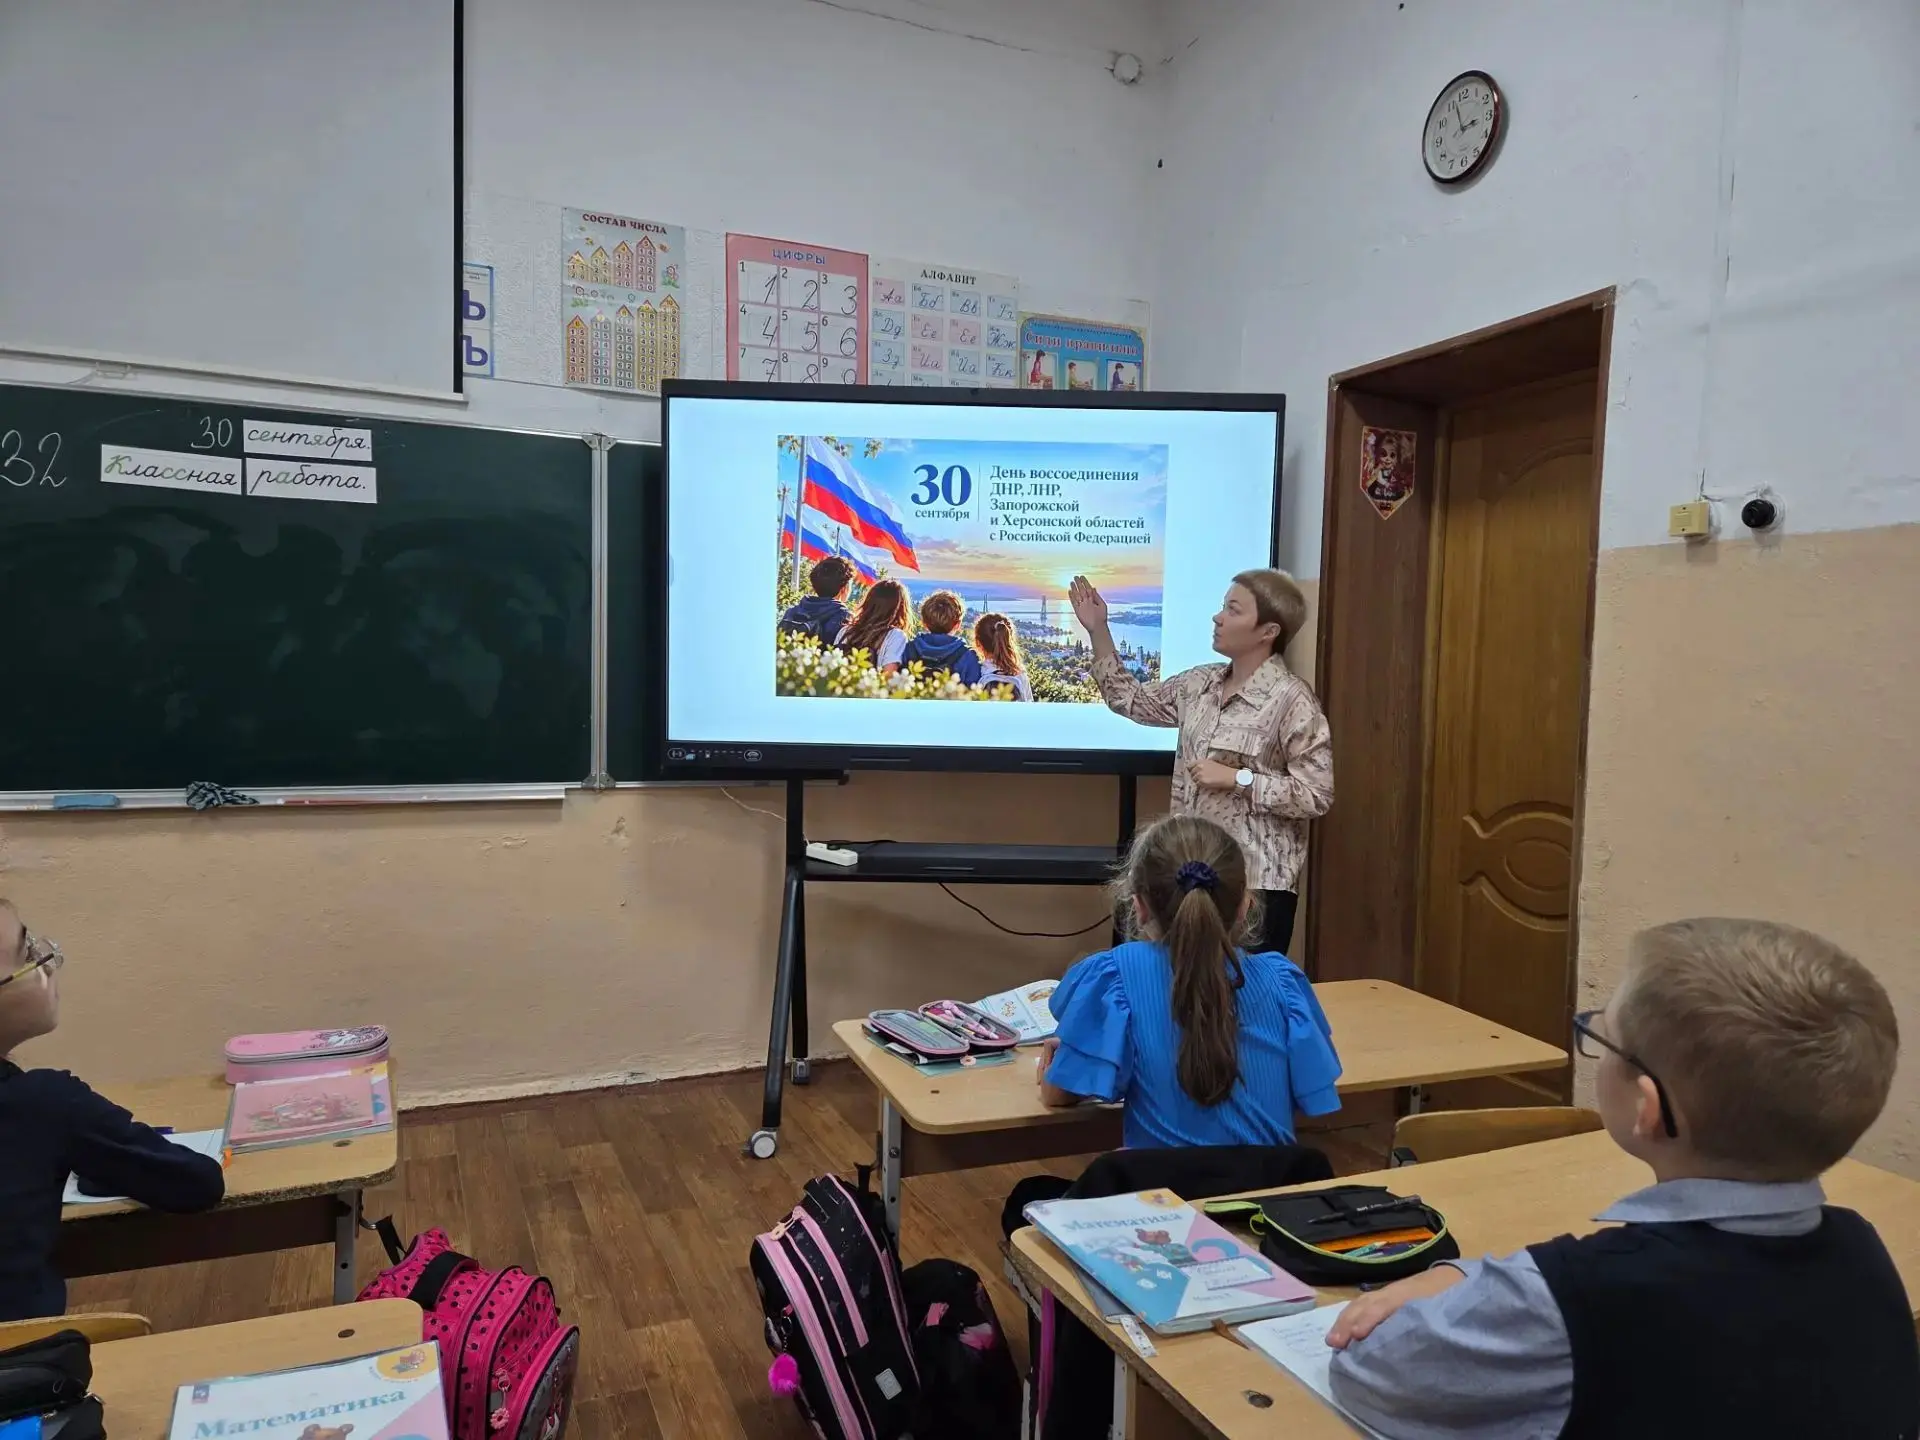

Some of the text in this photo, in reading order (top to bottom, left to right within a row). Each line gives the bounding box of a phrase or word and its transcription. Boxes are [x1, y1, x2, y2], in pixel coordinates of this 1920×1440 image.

[1459, 89, 1468, 102] 12
[1482, 94, 1489, 104] 2
[1485, 110, 1492, 120] 3
[1440, 117, 1447, 129] 10
[1436, 136, 1442, 148] 9
[1440, 151, 1446, 161] 8
[1473, 147, 1480, 157] 5
[1448, 160, 1454, 169] 7
[1461, 156, 1467, 167] 6
[583, 214, 667, 234] СОСТАВ ЧИСЛА
[772, 249, 825, 264] ЦИФРЫ
[740, 262, 778, 304] 1 1
[920, 270, 976, 285] АЛФАВИТ
[782, 268, 818, 310] 2 2
[822, 274, 857, 315] 3 3
[740, 304, 778, 347] 4 4
[782, 311, 818, 351] 5 5
[822, 316, 856, 356] 6 6
[740, 348, 778, 383] 7 7
[782, 352, 818, 383] 8 8
[822, 358, 828, 368] 9
[191, 416, 233, 449] 30
[104, 454, 367, 494] Классная работа.
[990, 465, 1139, 481] День воссоединения
[911, 464, 972, 506] 30
[990, 483, 1062, 497] ДНР, ЛНР,
[990, 499, 1080, 513] Запорожской
[915, 508, 970, 522] сентября
[990, 515, 1144, 529] и Херсонской областей
[999, 530, 1071, 542] Российской
[1074, 531, 1151, 546] Федерацией
[194, 1390, 407, 1439] Математика
